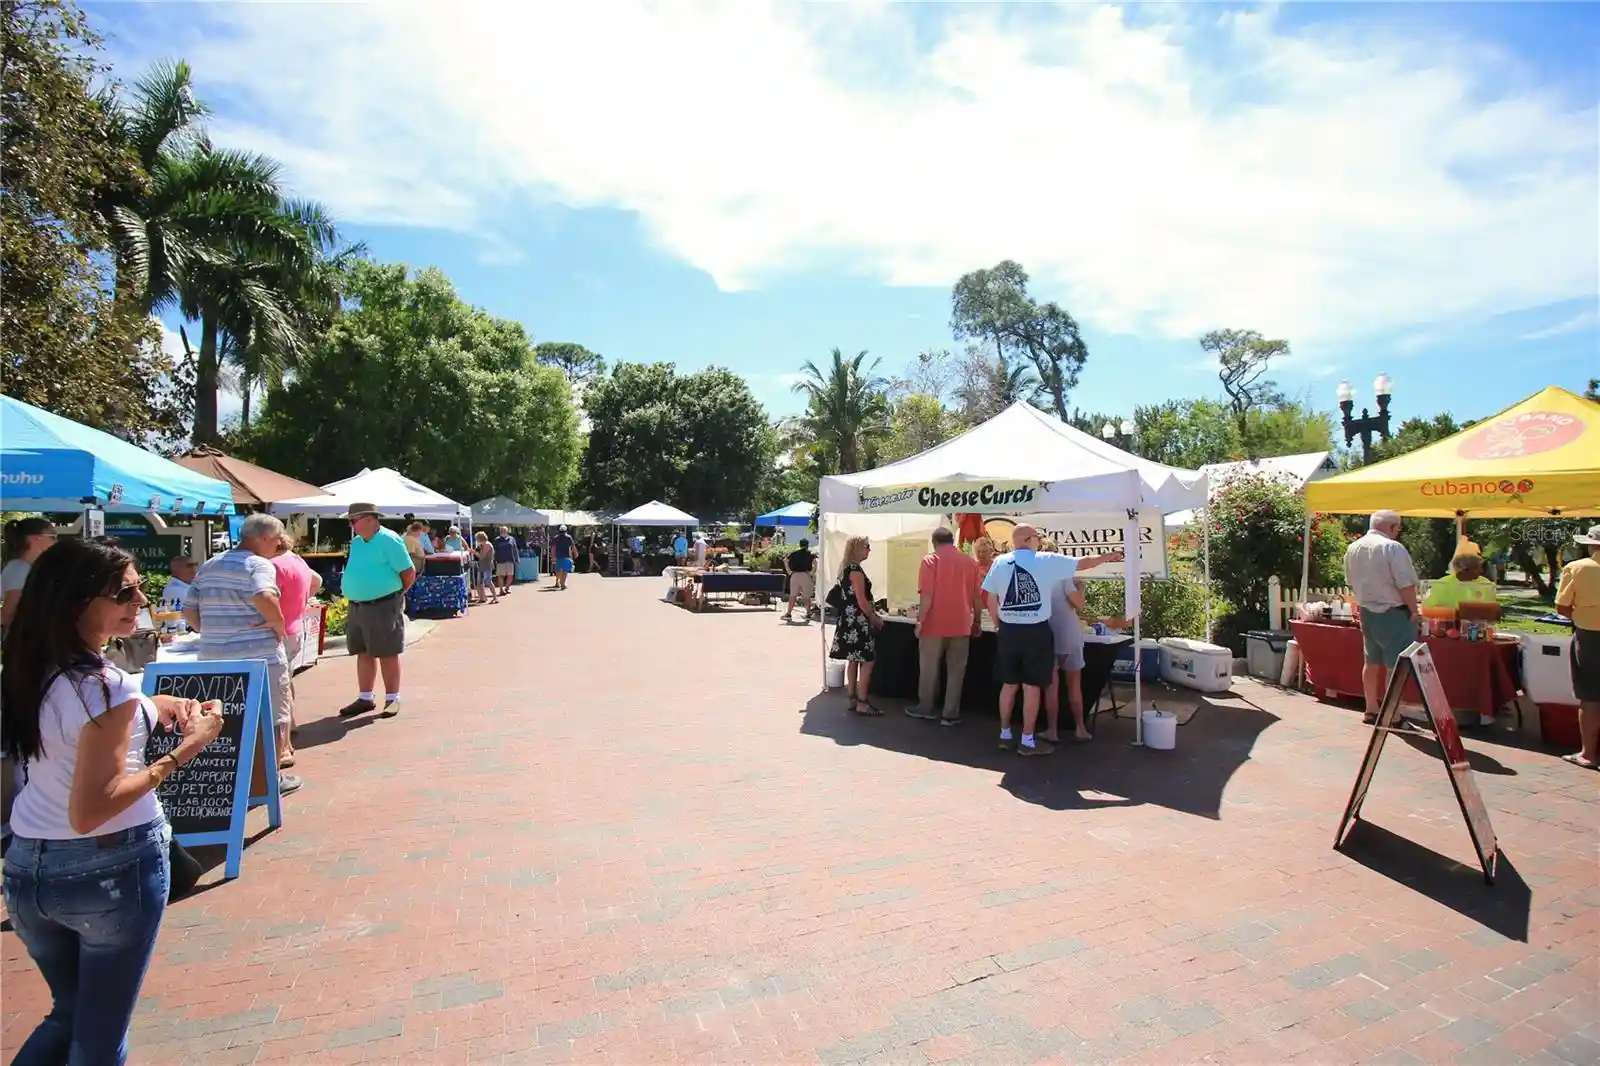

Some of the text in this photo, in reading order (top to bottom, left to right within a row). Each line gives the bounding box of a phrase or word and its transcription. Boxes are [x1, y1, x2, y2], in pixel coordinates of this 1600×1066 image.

[1420, 481, 1496, 496] Cubano
[1035, 526, 1153, 544] STAMPR
[158, 676, 246, 701] PROVIDA
[223, 702, 246, 715] EMP
[188, 770, 236, 783] SUPPORT
